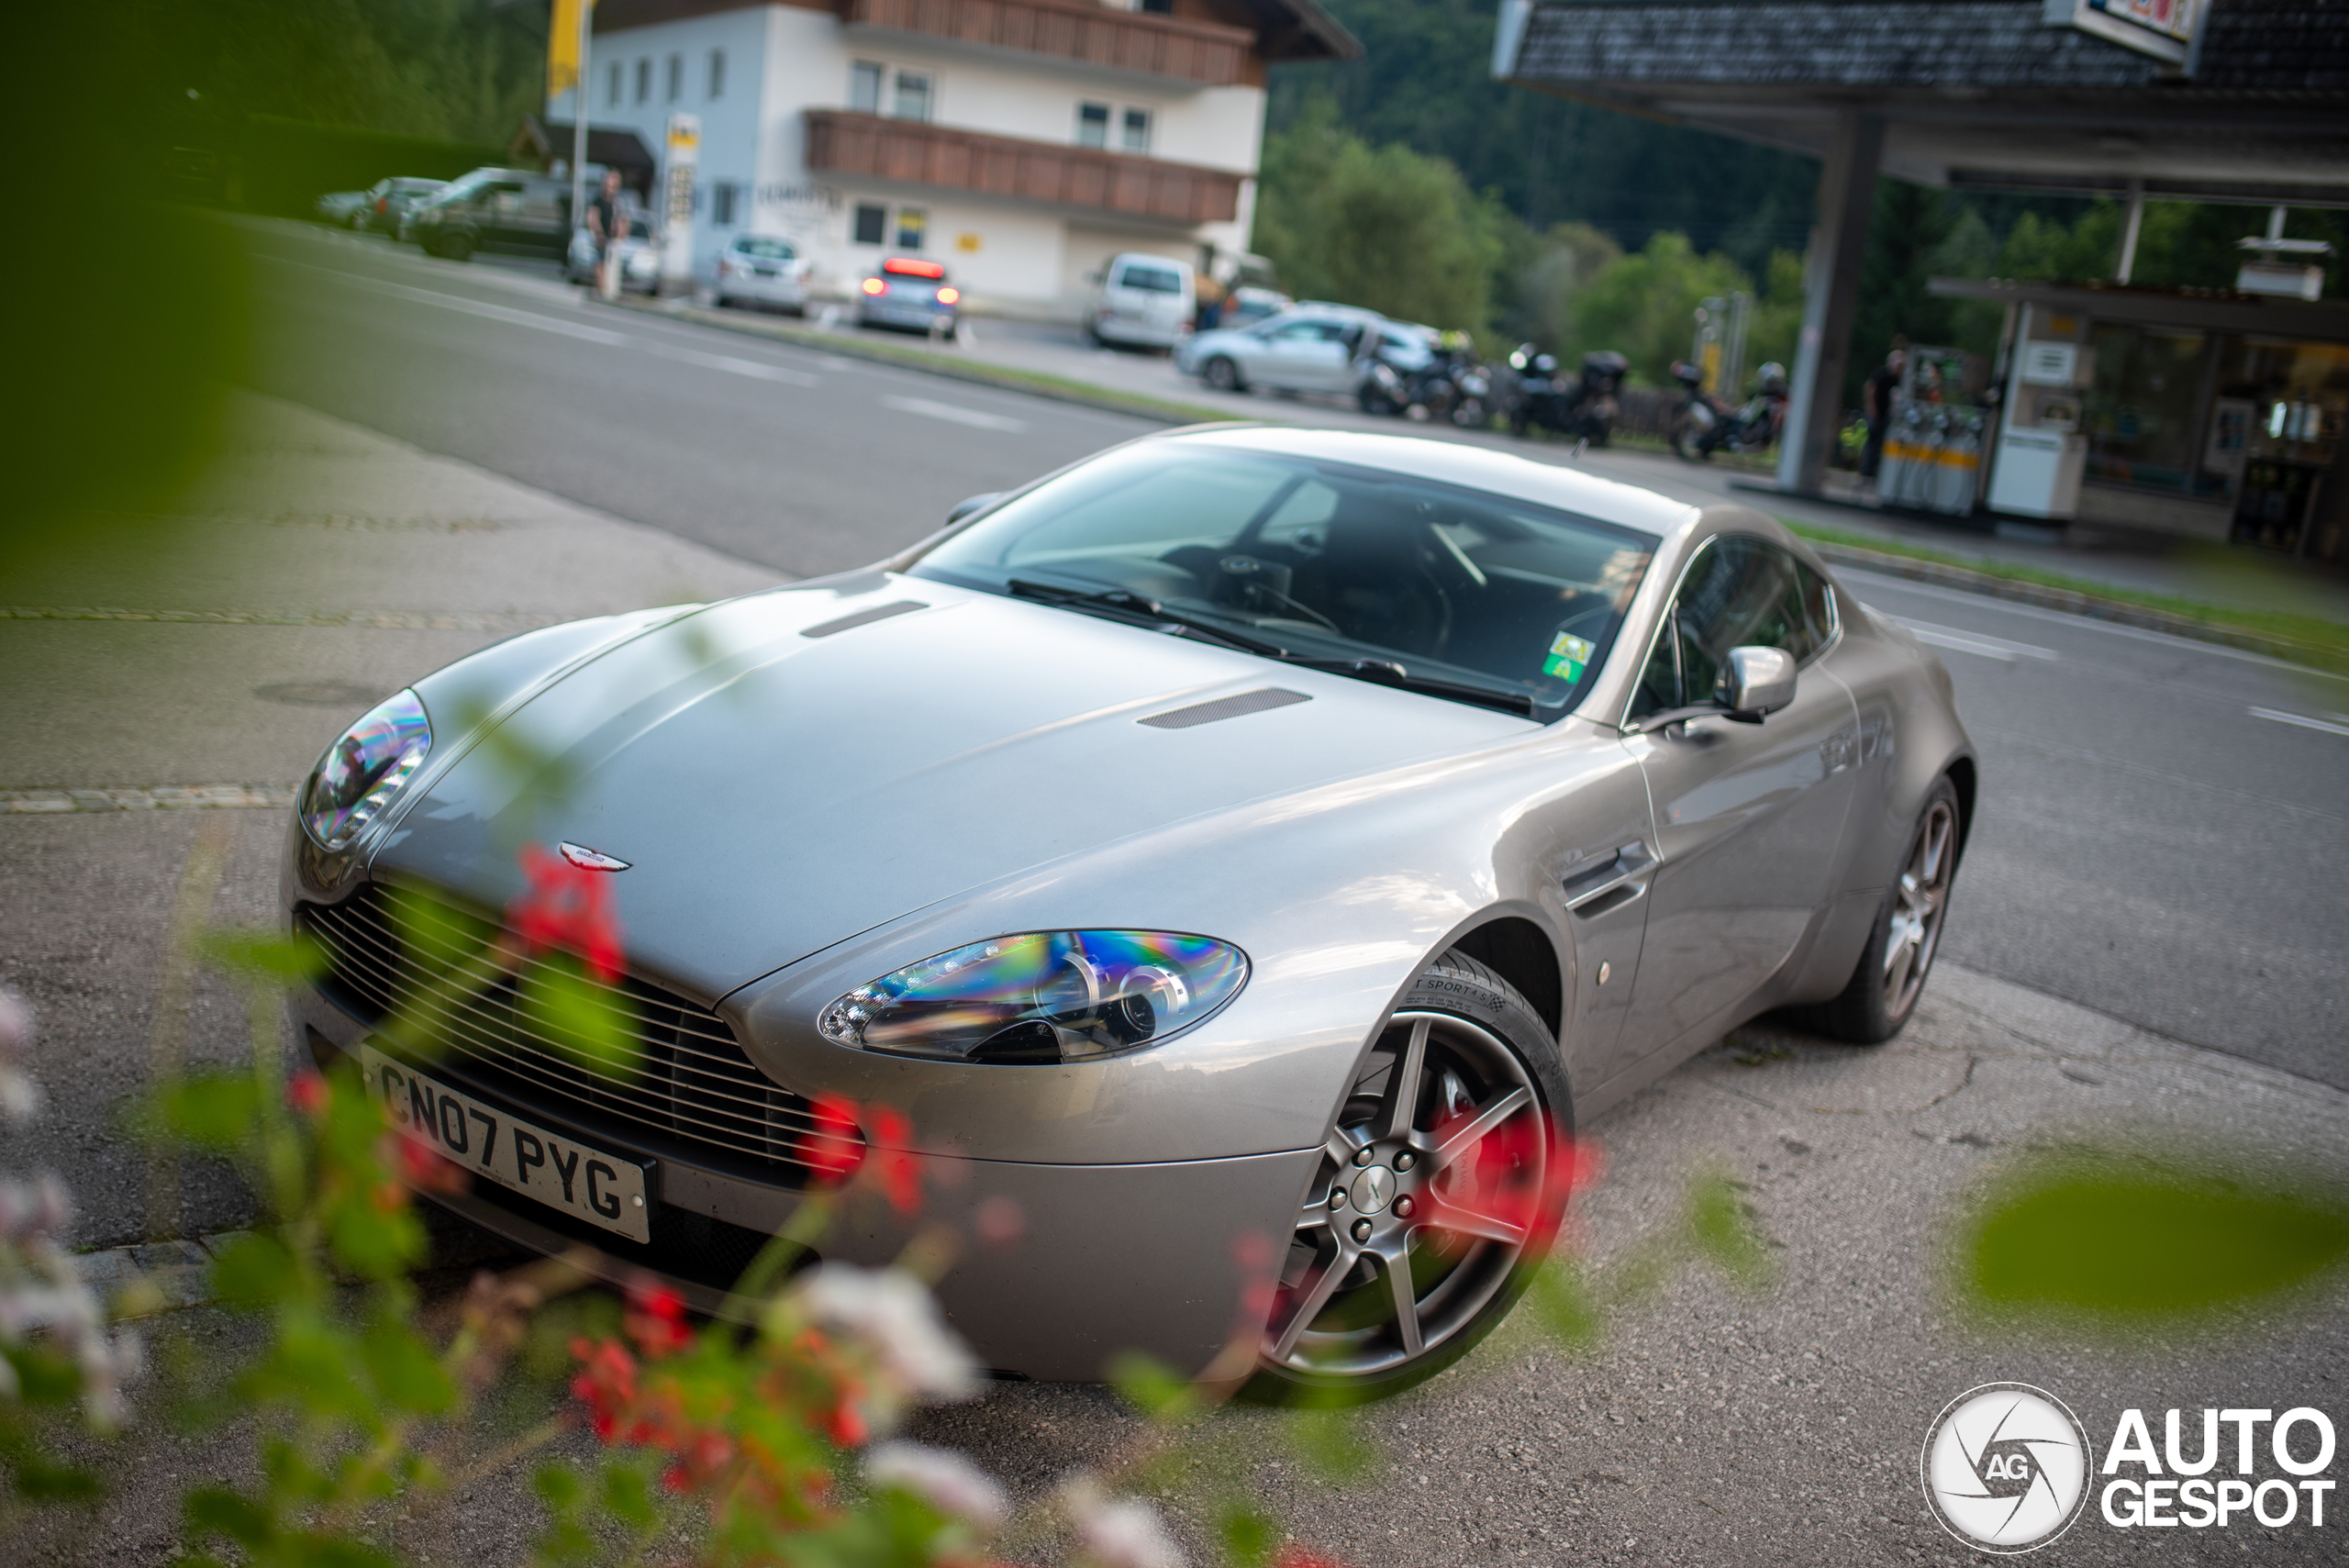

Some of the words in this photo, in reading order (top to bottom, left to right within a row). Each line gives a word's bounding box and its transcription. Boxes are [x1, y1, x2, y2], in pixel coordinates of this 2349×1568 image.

[1427, 979, 1472, 995] SPORT
[1479, 992, 1487, 1001] S
[381, 1063, 497, 1168] CN07
[512, 1127, 622, 1220] PYG
